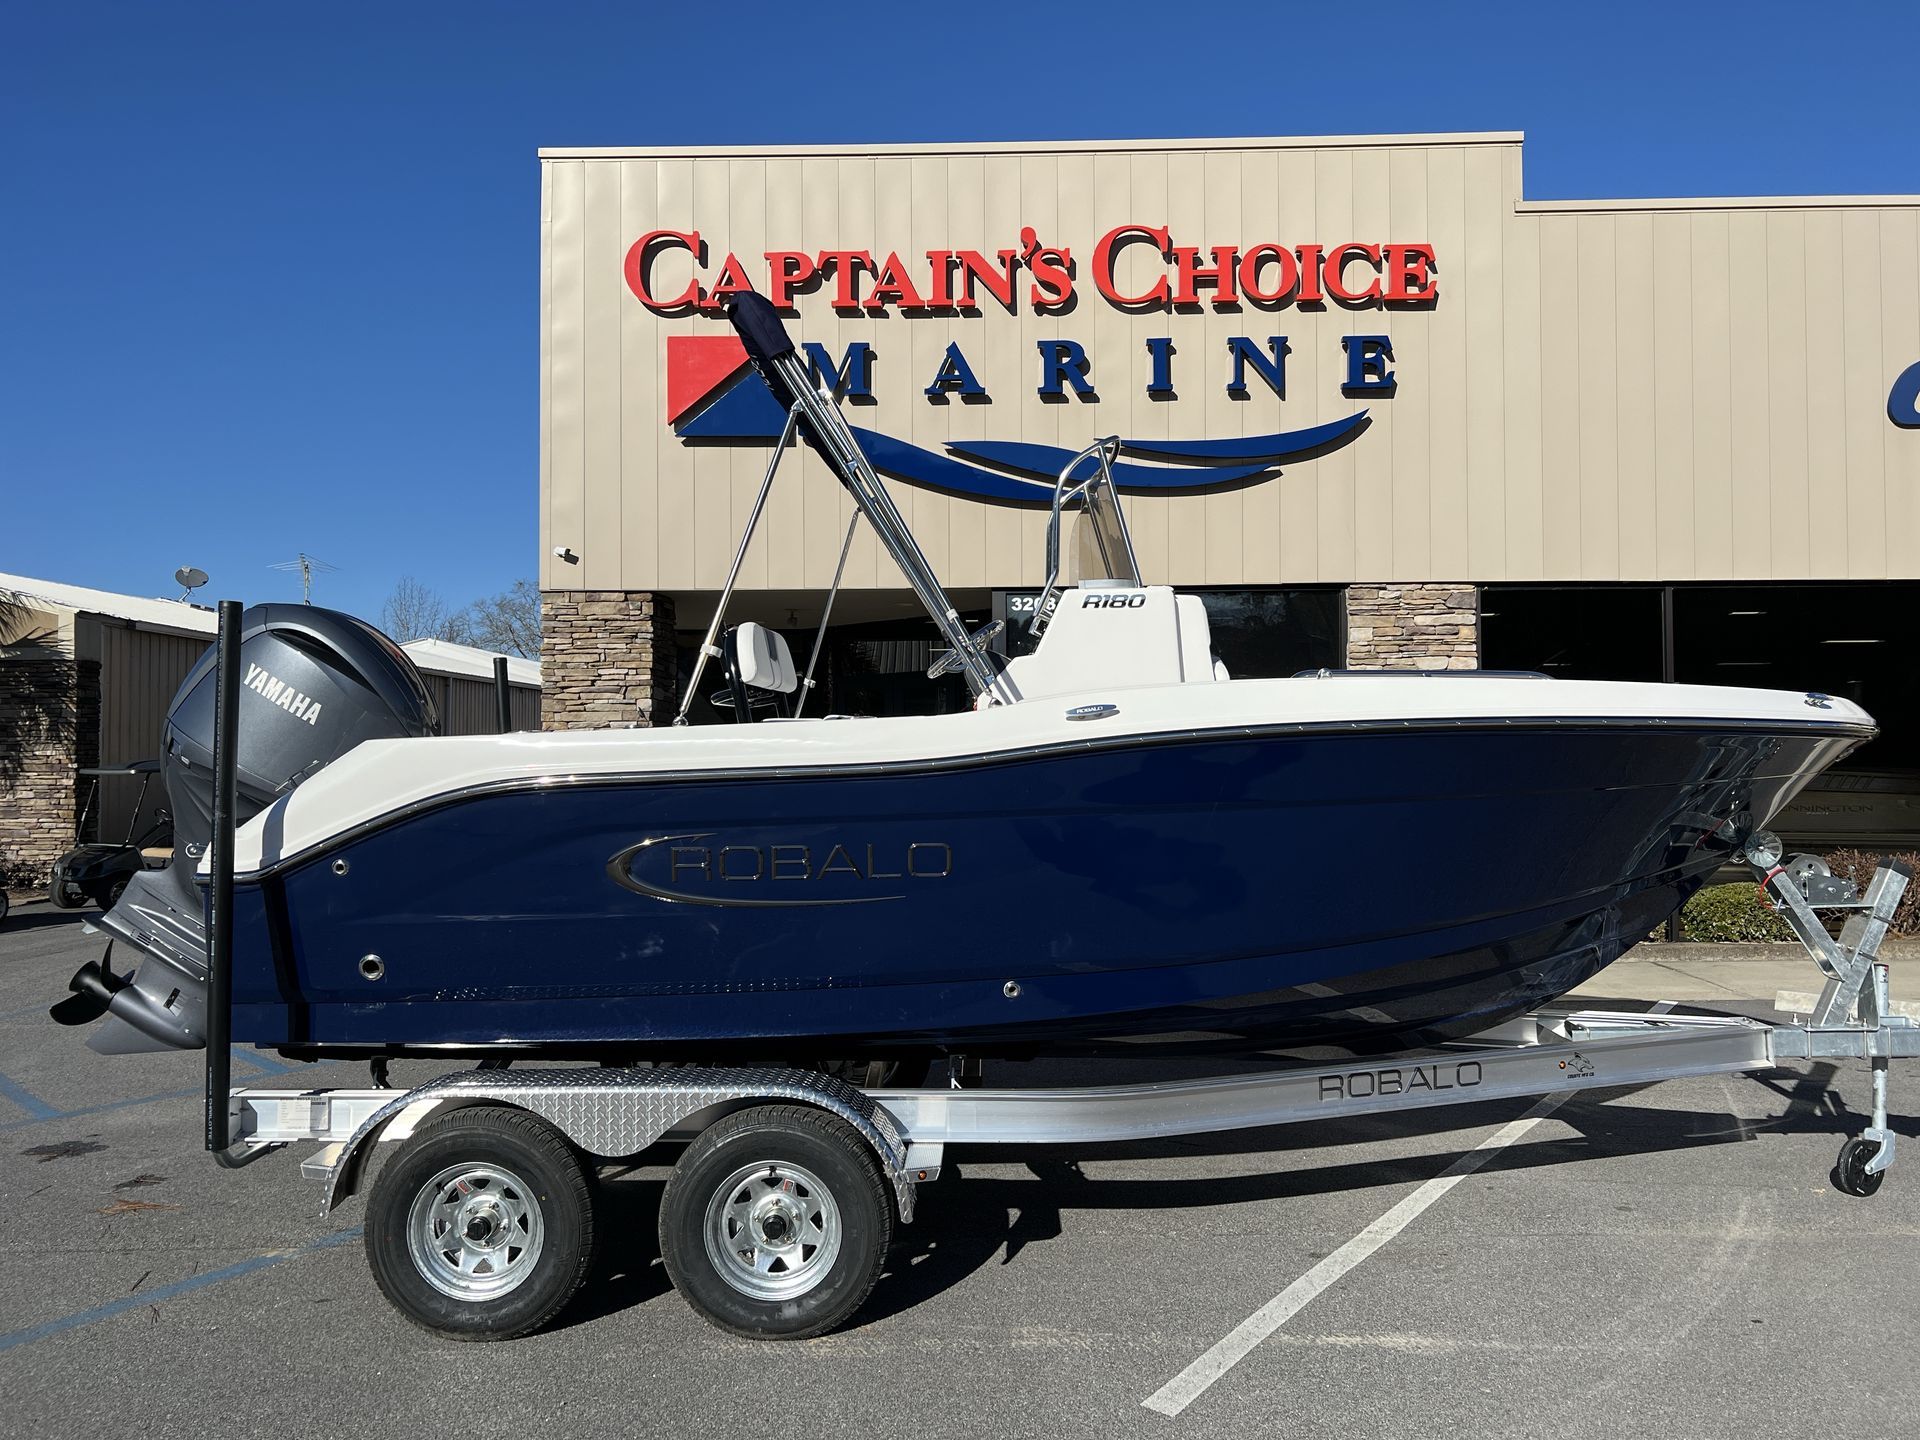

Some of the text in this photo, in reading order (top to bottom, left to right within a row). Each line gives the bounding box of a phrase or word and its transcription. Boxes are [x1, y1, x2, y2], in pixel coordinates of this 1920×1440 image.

[1092, 225, 1437, 304] CHOICE
[801, 336, 1396, 396] MARINE
[1082, 594, 1146, 608] R180
[243, 662, 322, 726] YAMAHA
[671, 843, 951, 882] ROBALO
[1318, 1061, 1482, 1101] ROBALO
